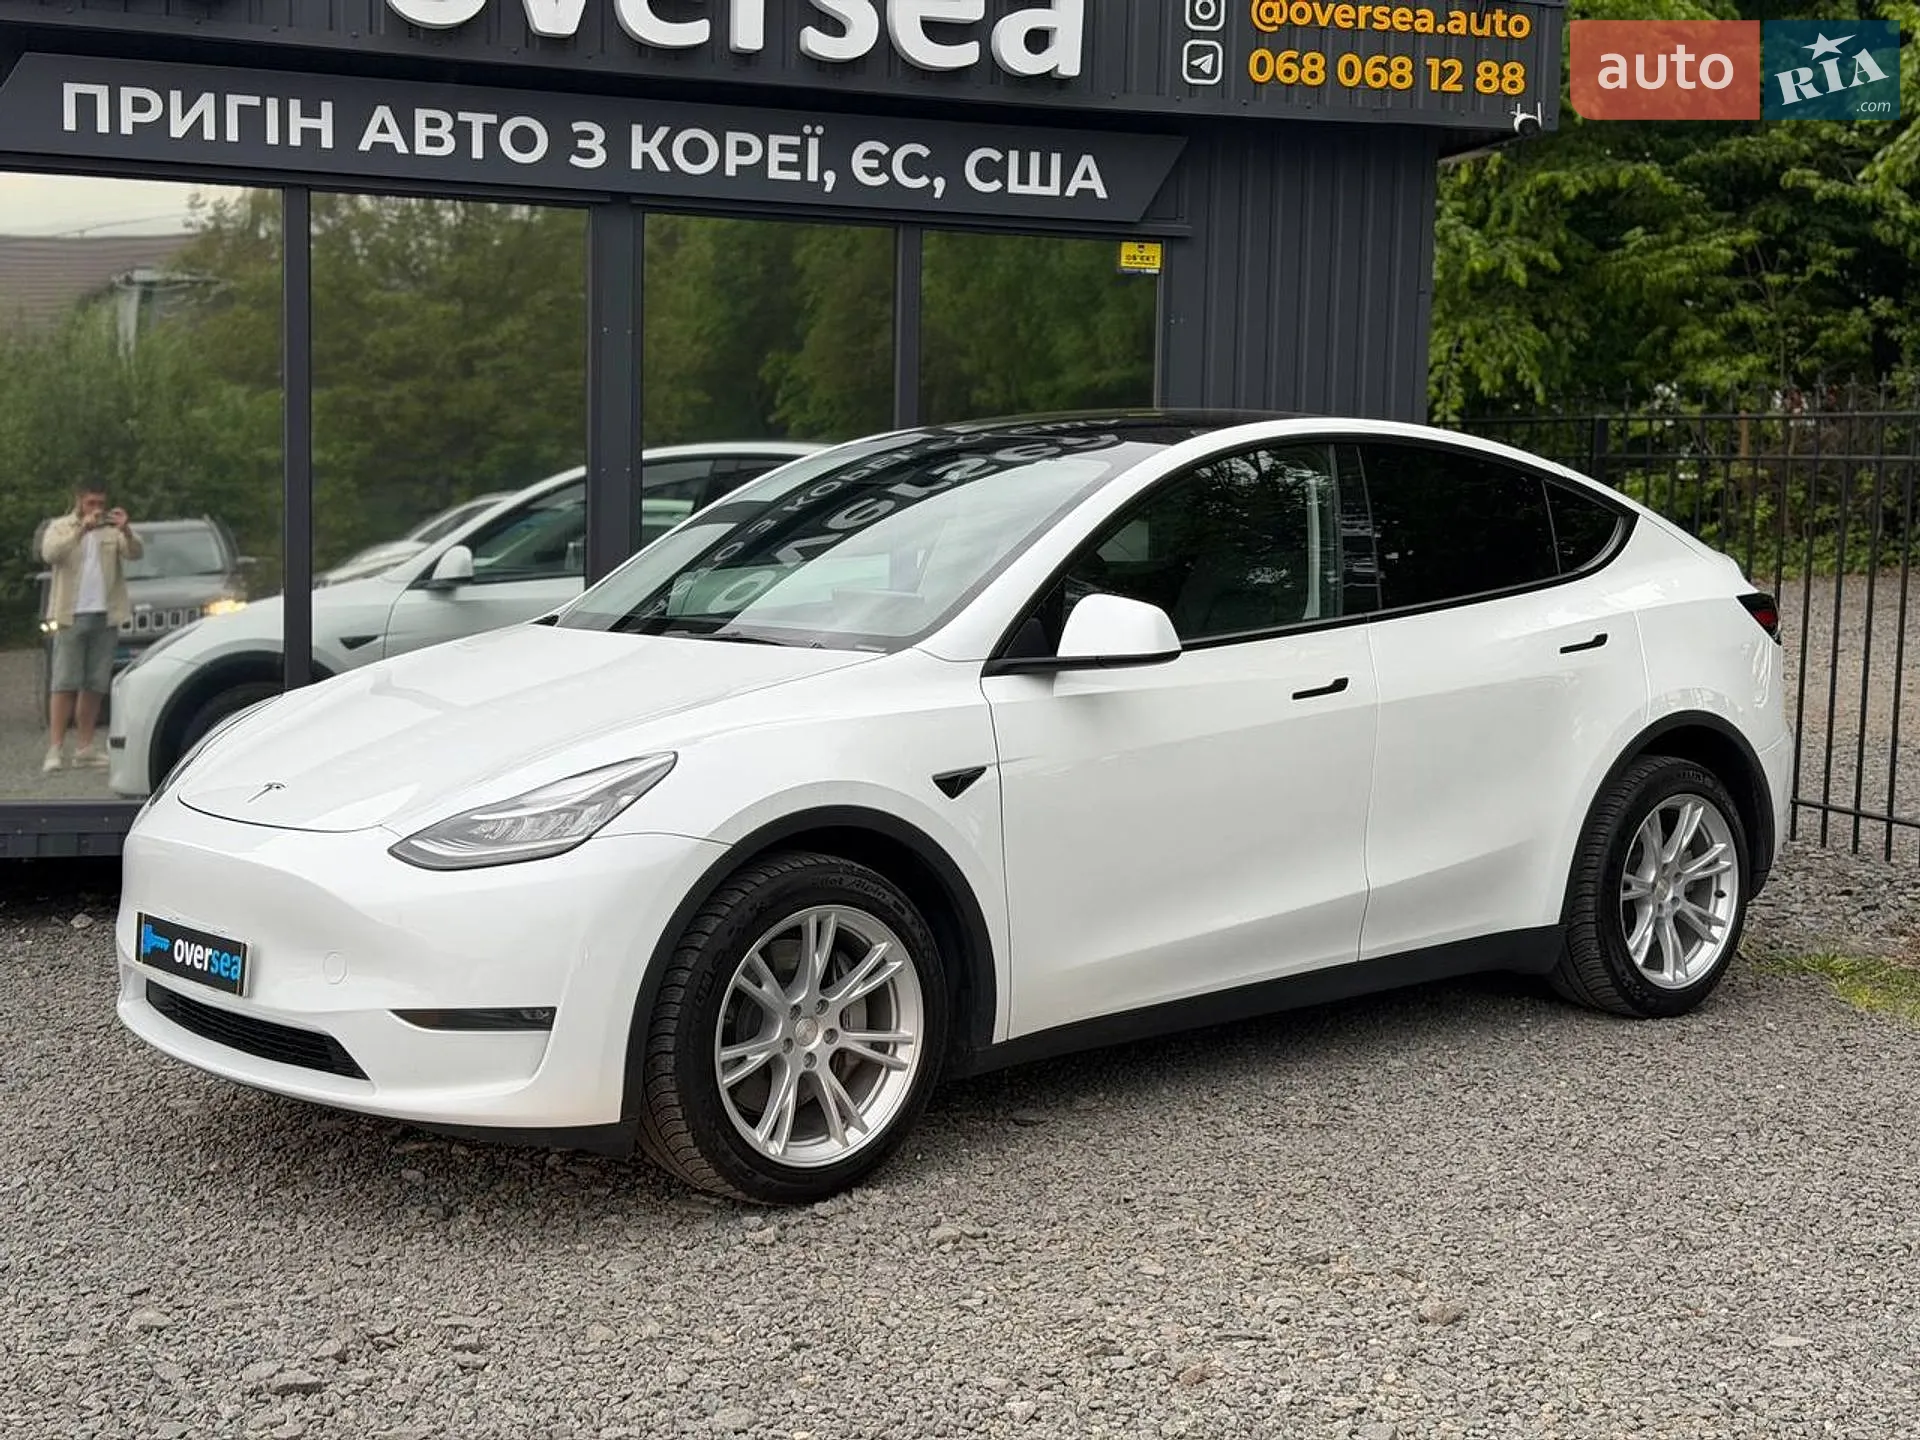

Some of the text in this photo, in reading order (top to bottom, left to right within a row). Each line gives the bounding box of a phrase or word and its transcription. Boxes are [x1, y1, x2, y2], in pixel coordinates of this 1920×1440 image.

[1251, 0, 1531, 39] @oversea.auto
[1249, 48, 1526, 95] 068 068 12 88
[62, 82, 1108, 199] ПРИГІН АВТО З КОРЕЇ, ЄС, США
[173, 938, 242, 980] oversea
